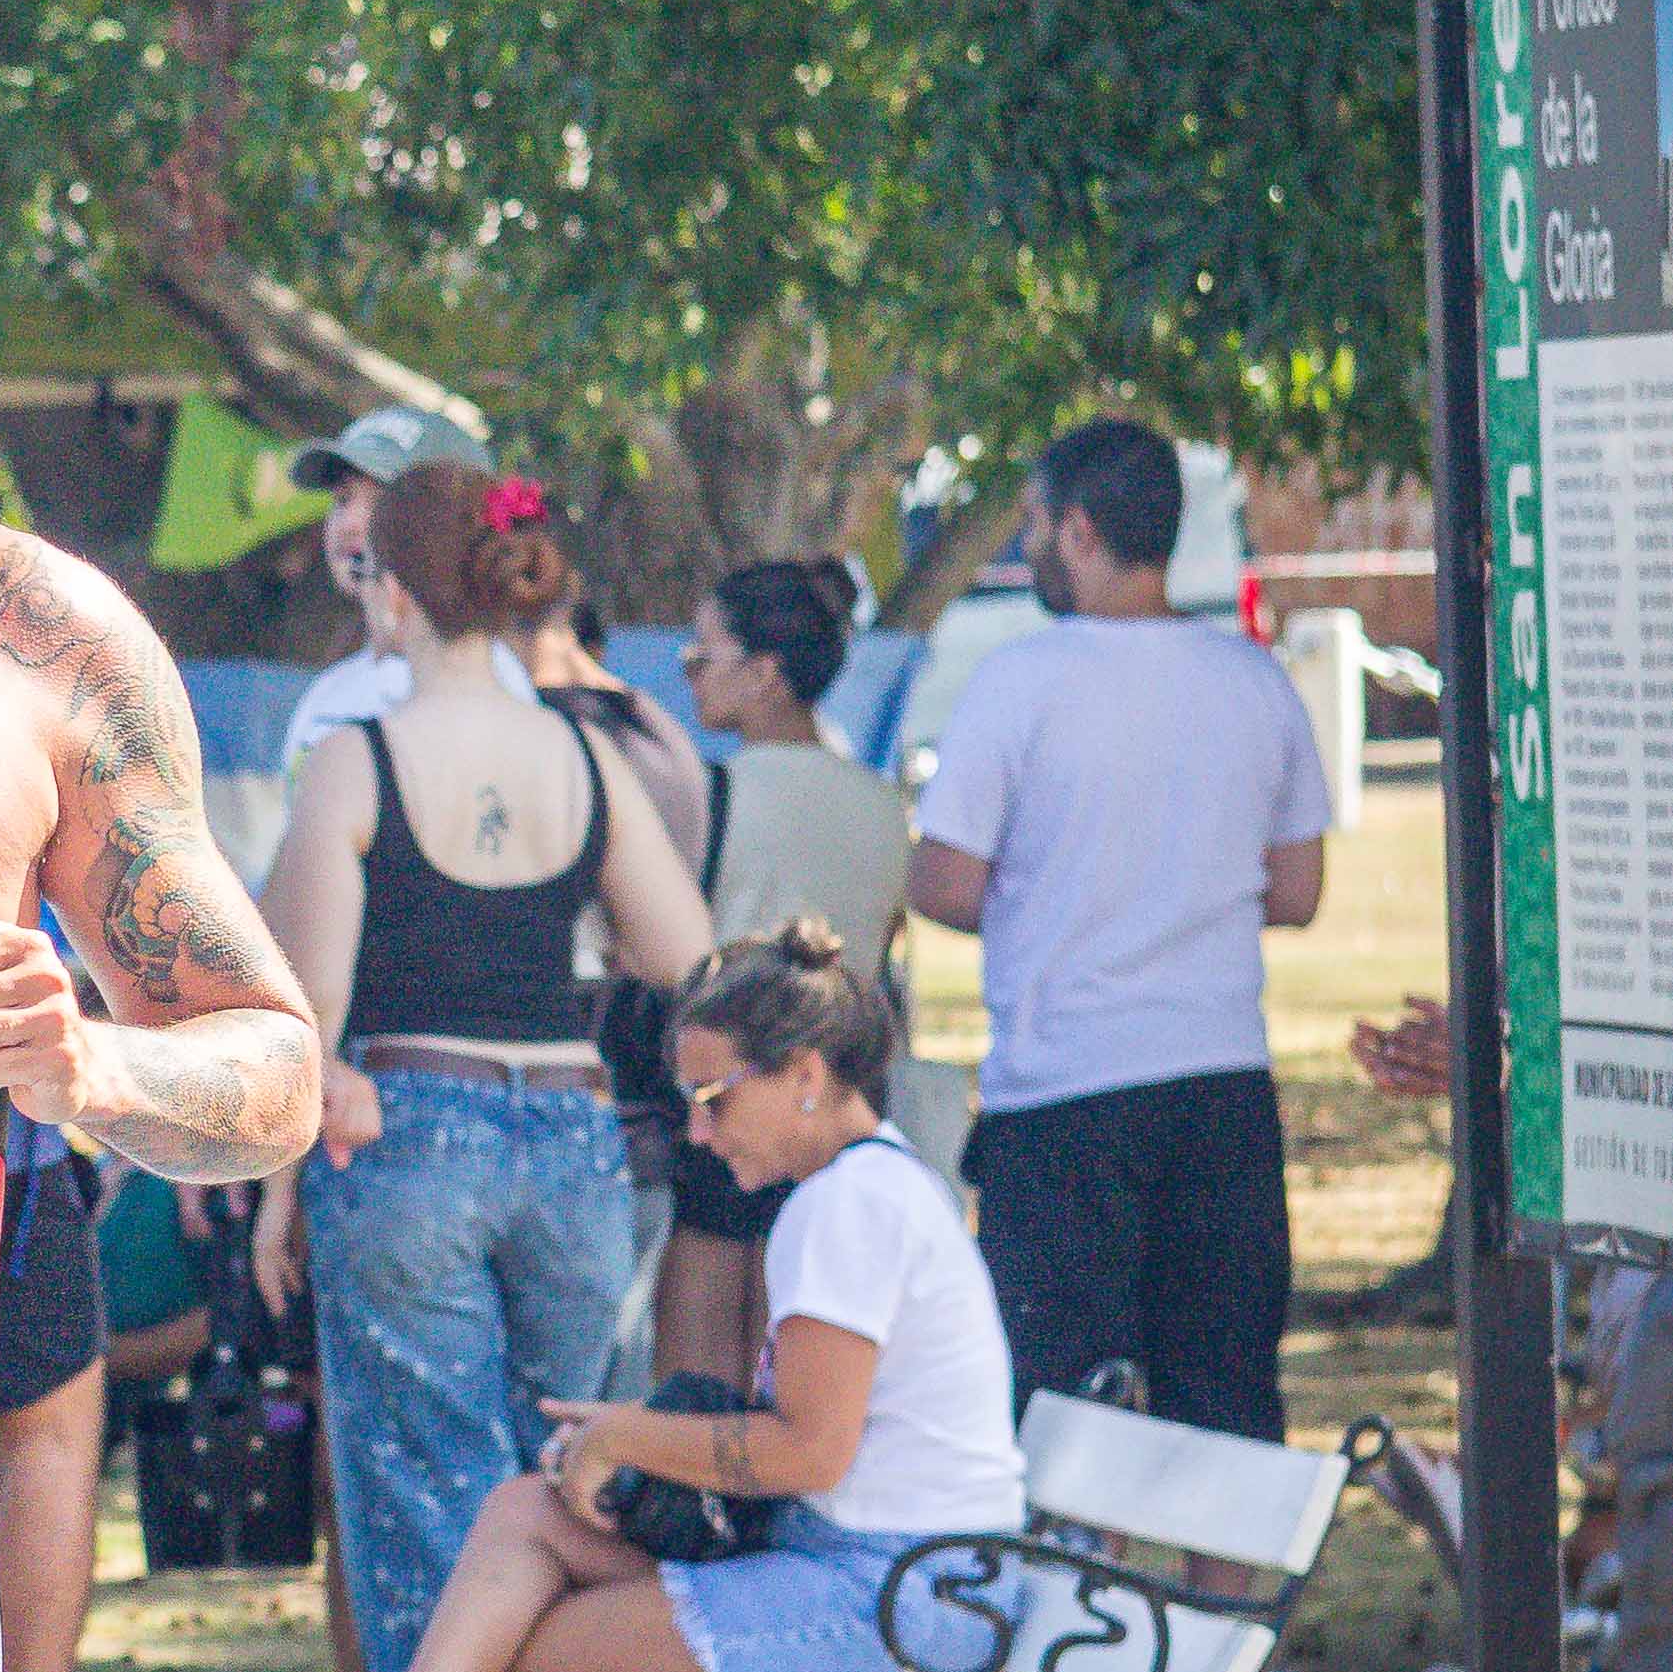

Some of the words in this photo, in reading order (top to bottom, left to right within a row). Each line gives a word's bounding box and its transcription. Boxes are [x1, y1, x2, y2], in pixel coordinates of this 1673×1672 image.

[1541, 70, 1573, 169] de
[1575, 69, 1599, 167] la
[1545, 205, 1617, 304] Gloria
[1507, 464, 1545, 801] San
